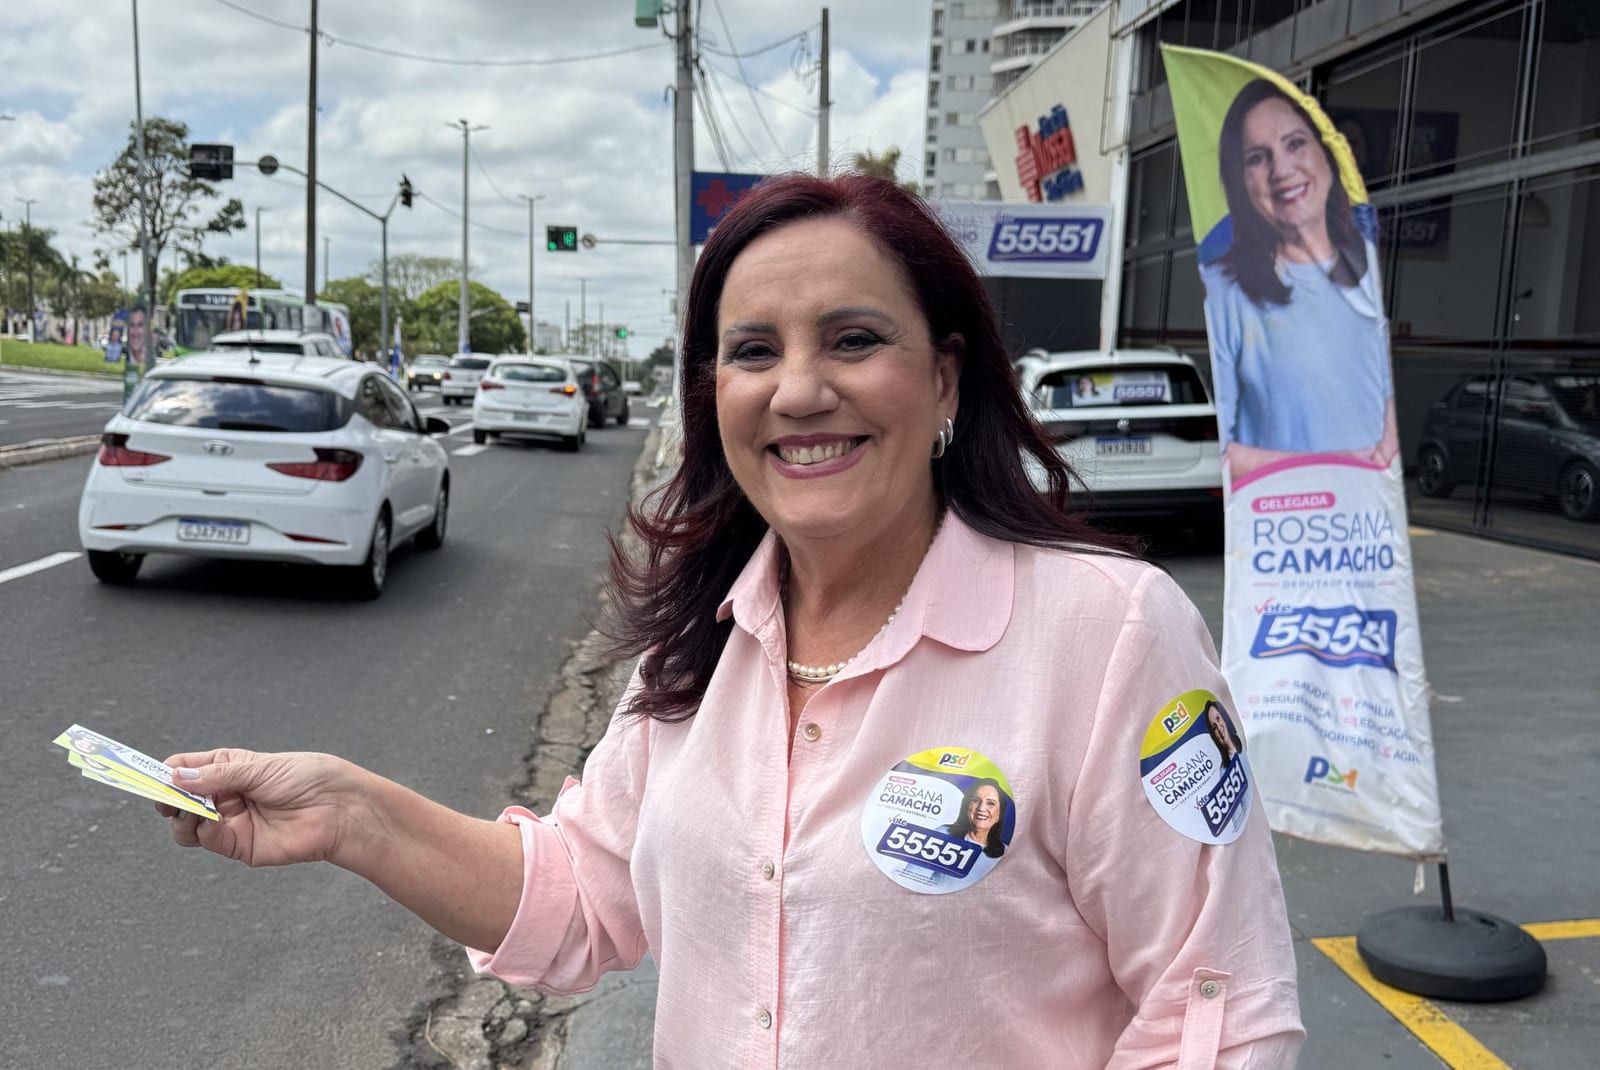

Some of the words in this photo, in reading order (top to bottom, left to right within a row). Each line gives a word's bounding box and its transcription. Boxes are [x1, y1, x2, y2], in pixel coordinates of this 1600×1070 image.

[995, 223, 1096, 254] 55551
[1259, 495, 1328, 511] DELEGADA
[1252, 509, 1394, 546] ROSSANA
[1252, 544, 1394, 574] CAMACHO
[1163, 702, 1188, 733] psd
[938, 753, 970, 765] psd
[1155, 751, 1209, 797] ROSSANA
[883, 782, 943, 805] ROSSANA
[1164, 759, 1213, 806] CAMACHO
[1207, 762, 1246, 825] 55551
[879, 793, 942, 816] CAMACHO
[886, 827, 974, 870] 55551
